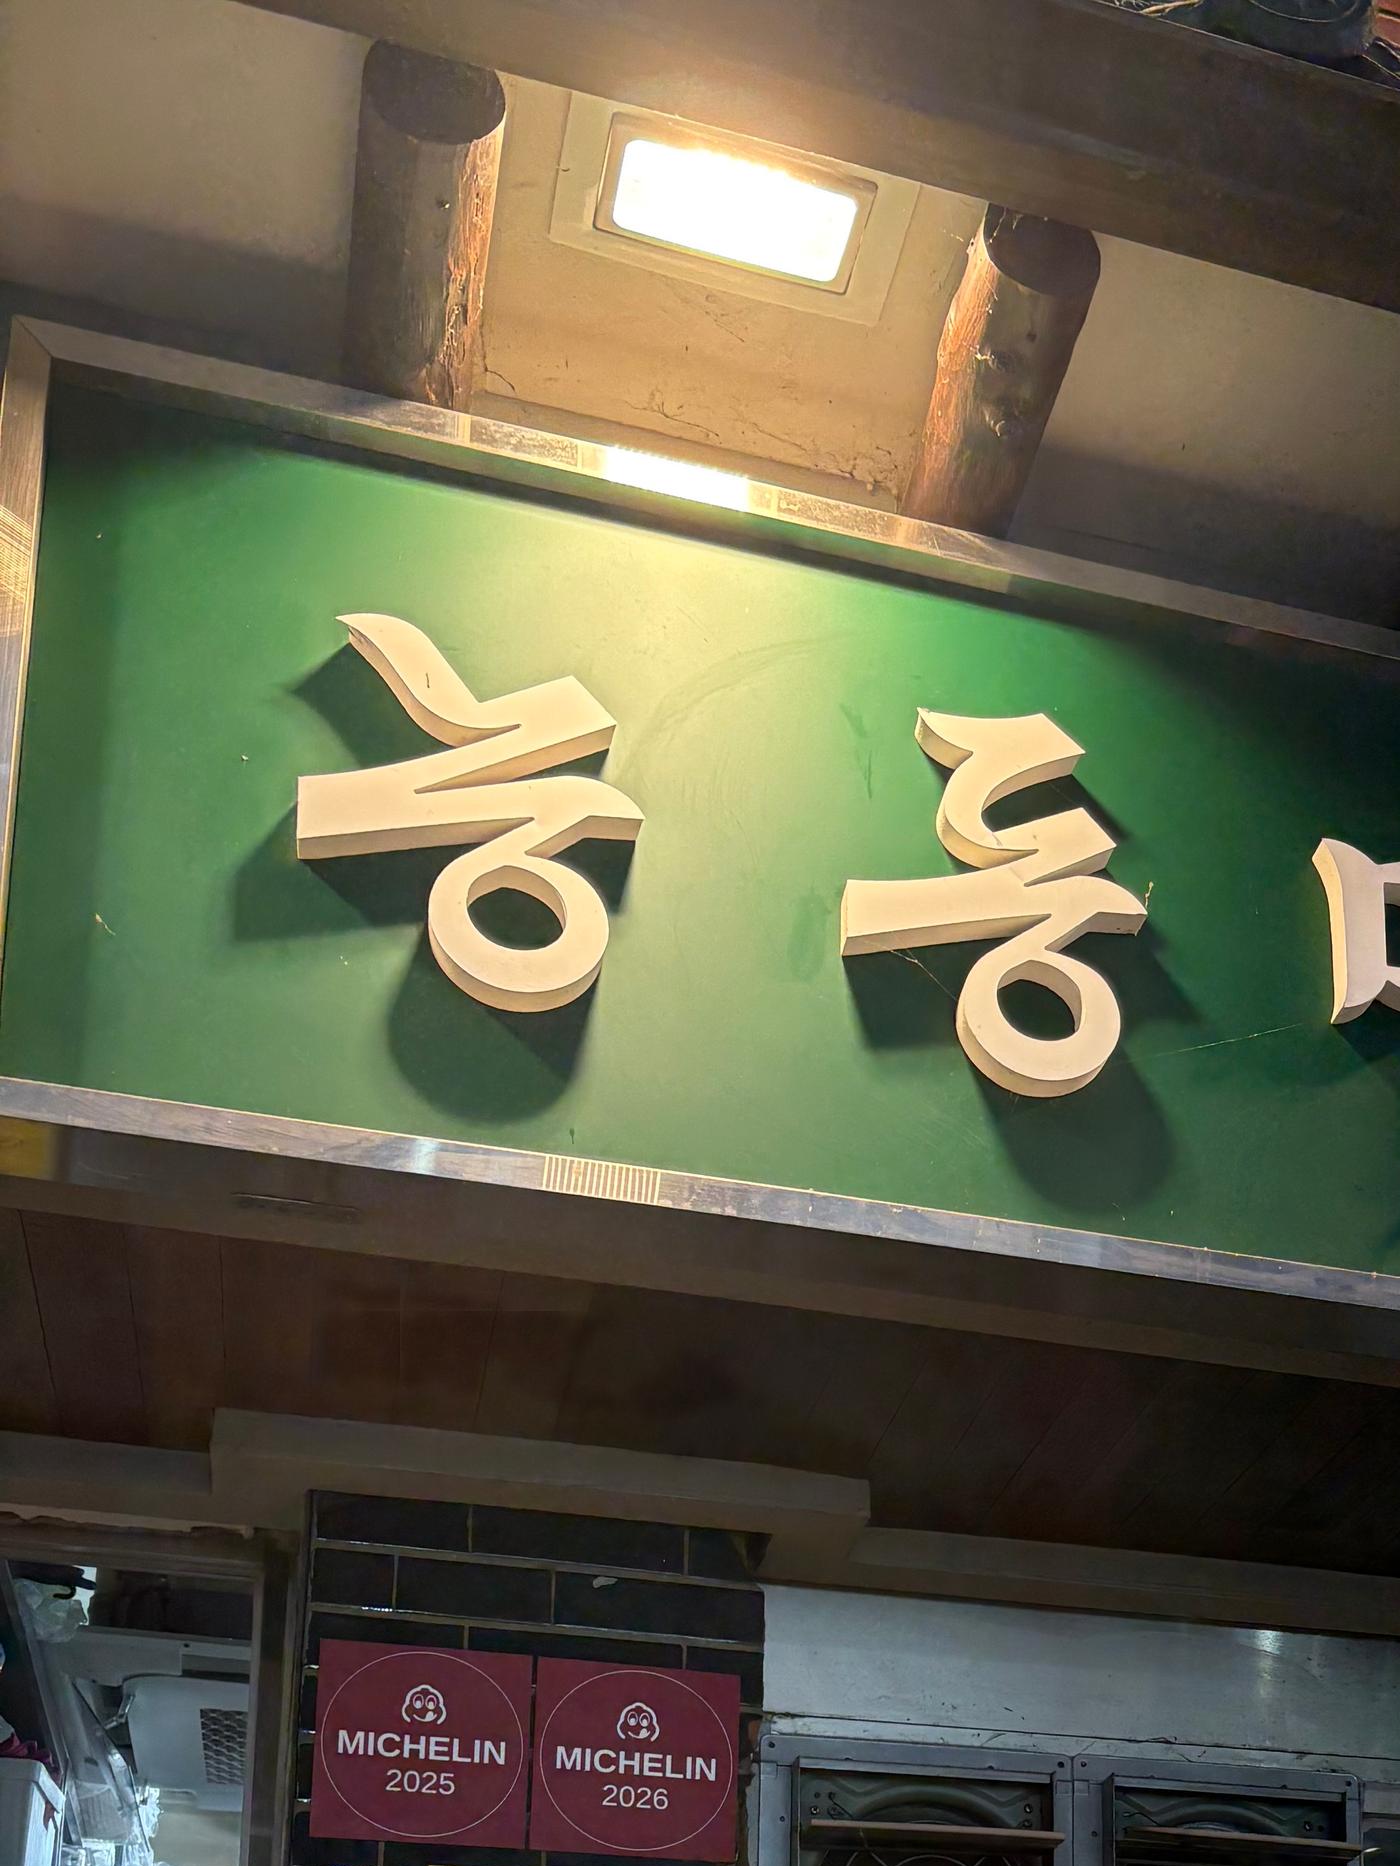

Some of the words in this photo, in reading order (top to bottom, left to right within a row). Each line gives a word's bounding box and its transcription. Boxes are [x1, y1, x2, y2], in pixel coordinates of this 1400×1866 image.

[337, 1730, 507, 1765] MICHELIN
[555, 1746, 717, 1782] MICHELIN
[385, 1769, 455, 1795] 2025
[601, 1786, 669, 1810] 2026
